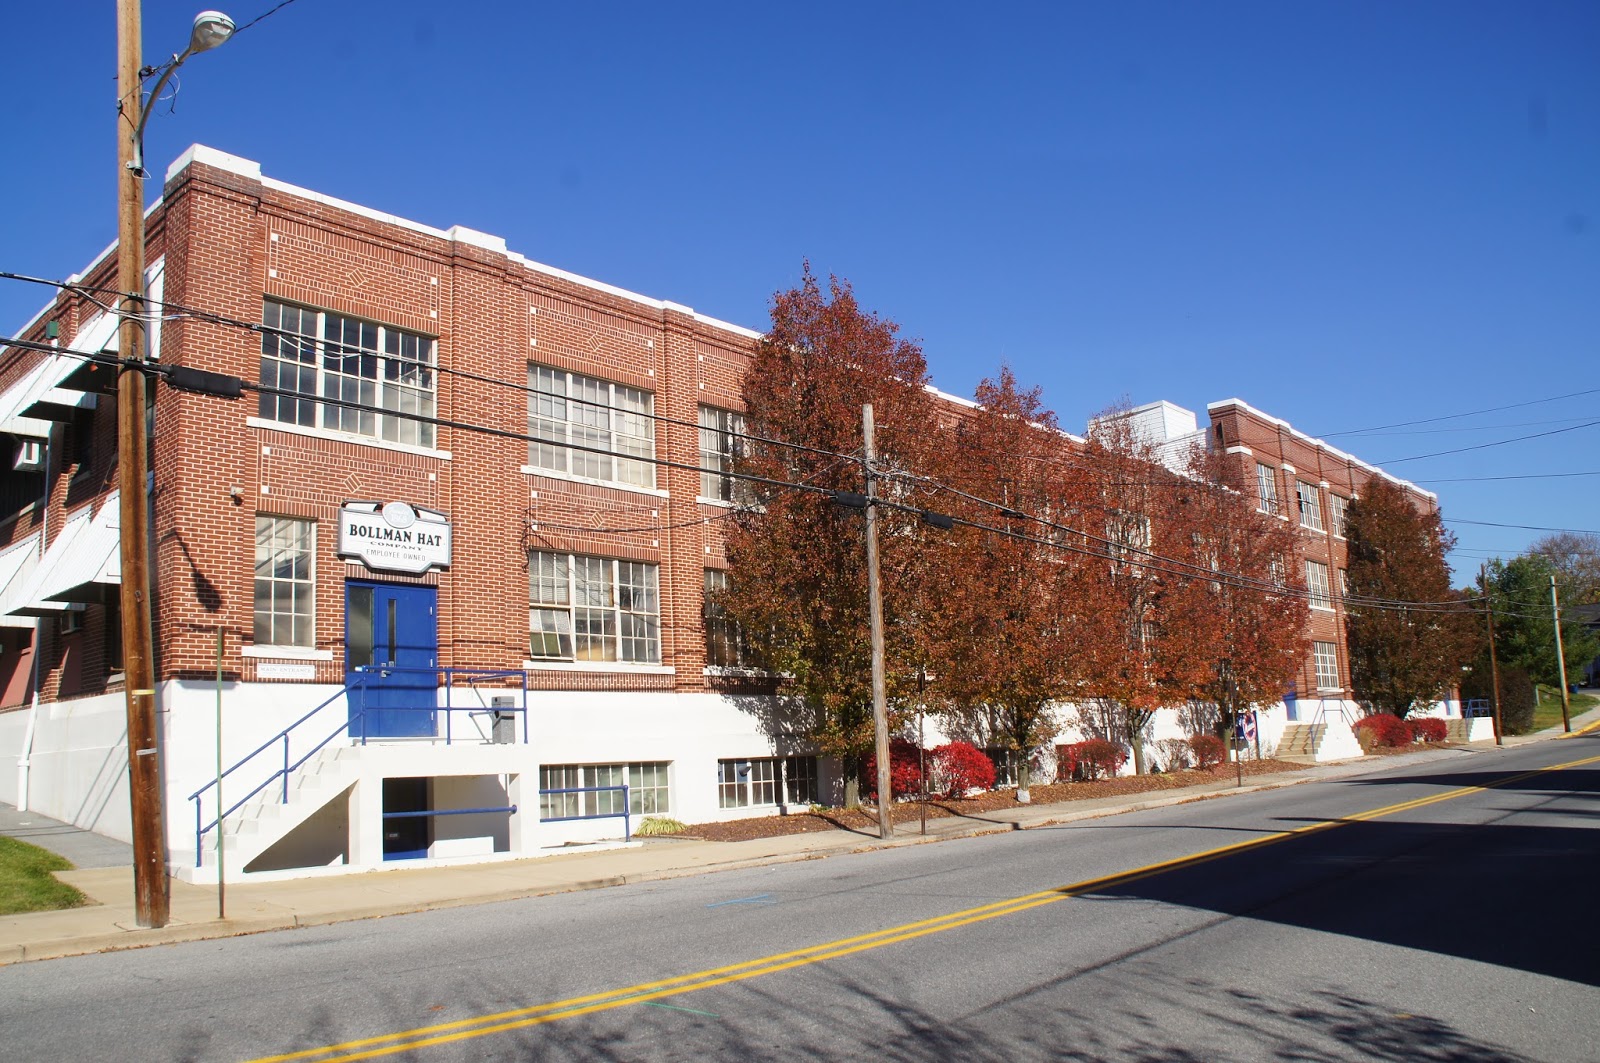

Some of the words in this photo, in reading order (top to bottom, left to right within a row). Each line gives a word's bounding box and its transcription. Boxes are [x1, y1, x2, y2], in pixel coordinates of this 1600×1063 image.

[349, 524, 412, 542] BOLLMAN
[417, 533, 442, 547] HAT
[370, 541, 423, 551] COMPANY
[366, 549, 400, 559] EMPLOYEE
[403, 553, 426, 561] OWNED
